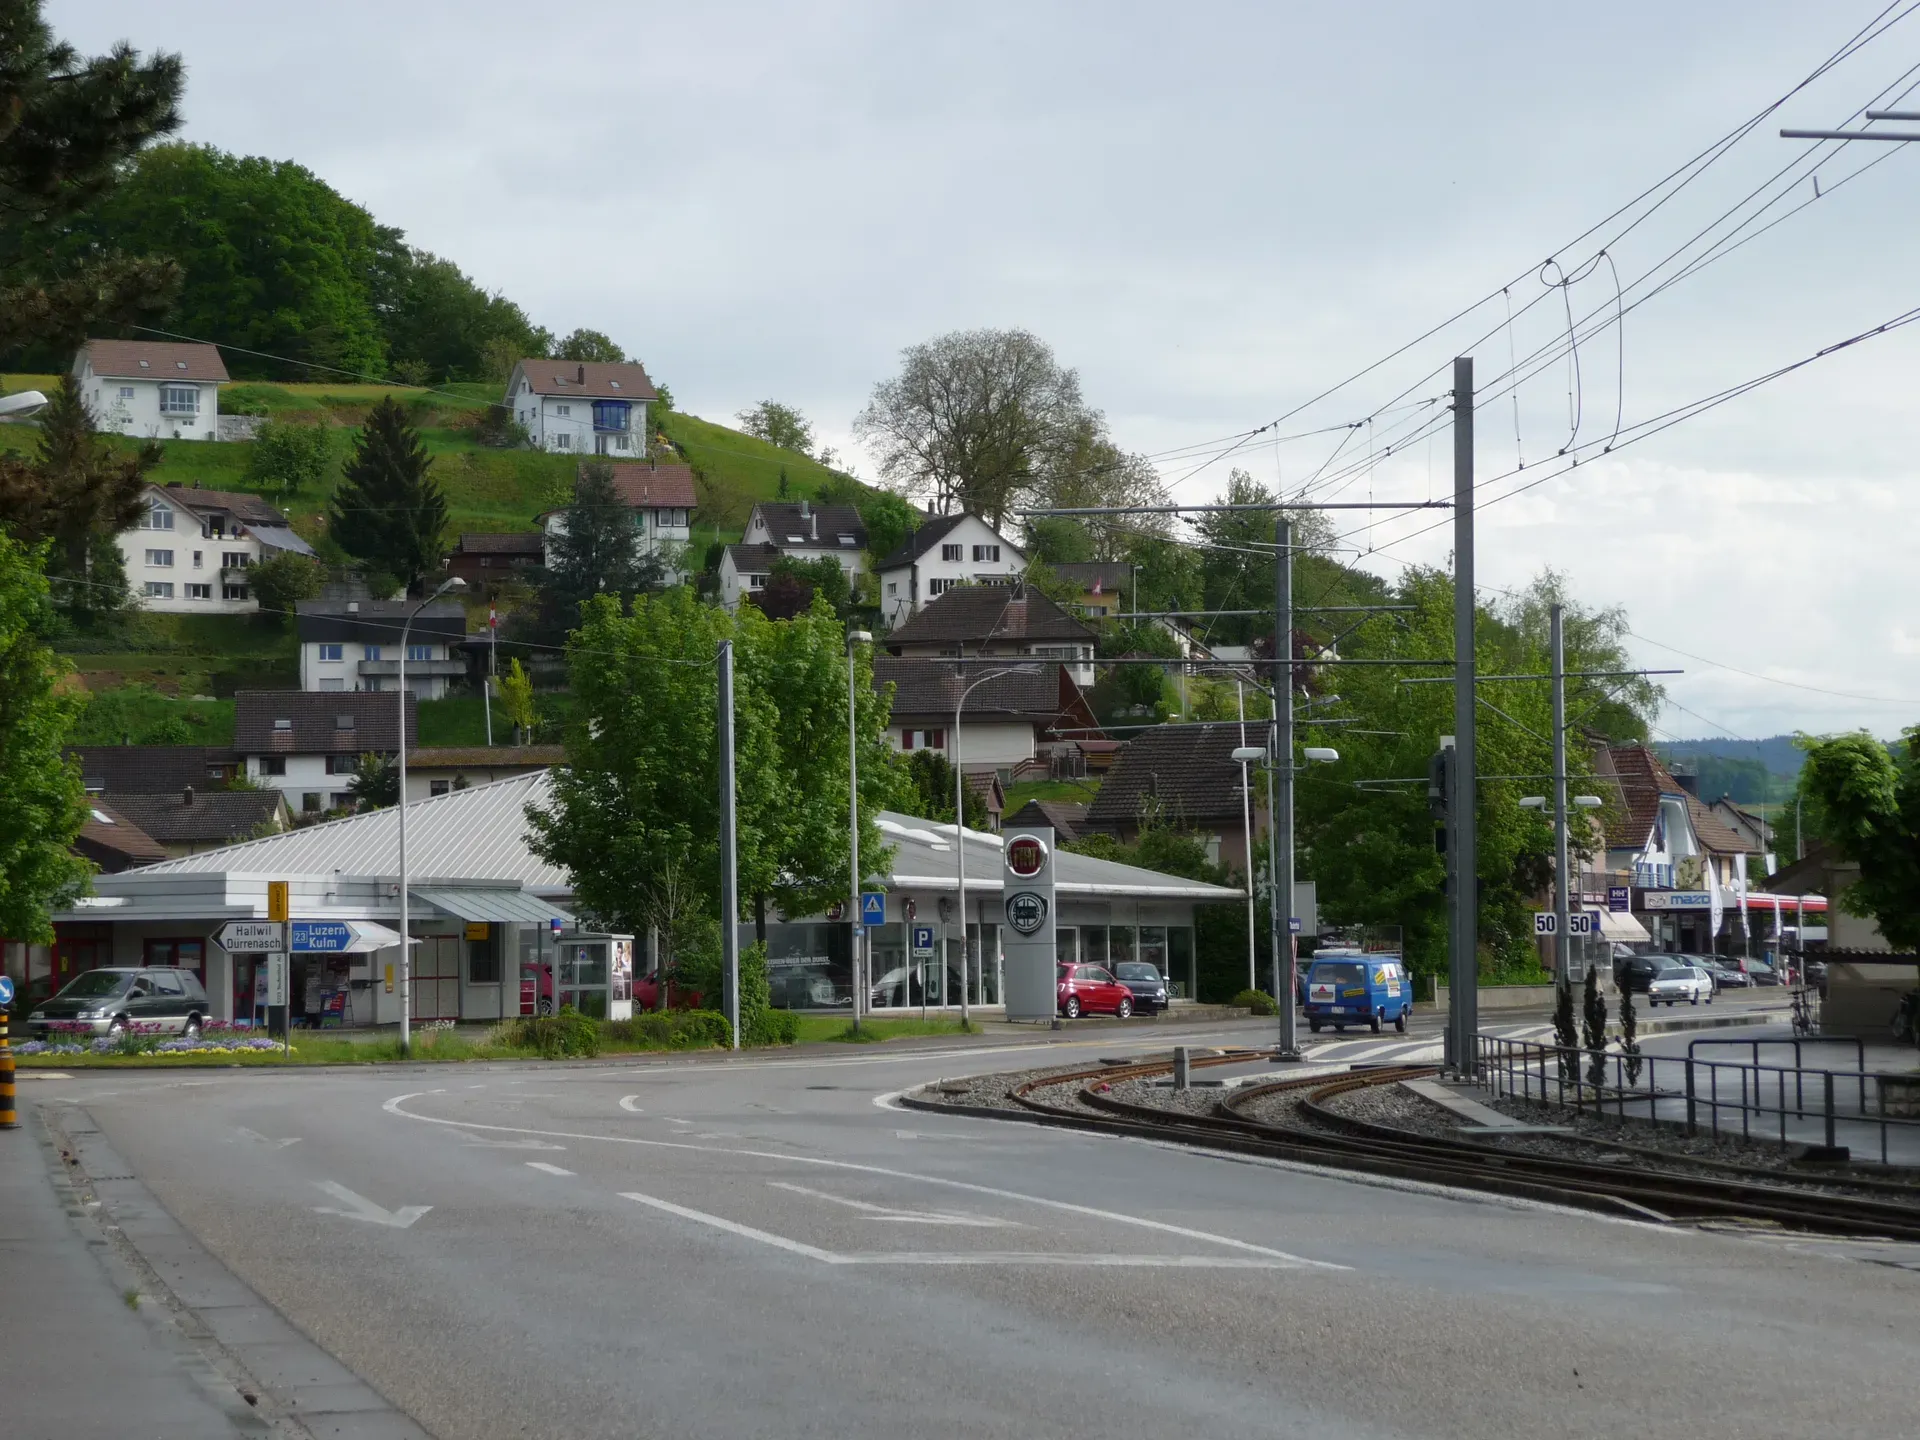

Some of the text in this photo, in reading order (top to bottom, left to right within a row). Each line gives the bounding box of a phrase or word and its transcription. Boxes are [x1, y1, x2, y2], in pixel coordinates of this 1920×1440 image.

[1014, 846, 1037, 867] FIAT
[1670, 895, 1712, 904] mazd
[1536, 915, 1555, 932] 50
[1570, 916, 1589, 933] 50
[236, 925, 272, 936] Hallwil
[309, 925, 346, 936] Luzern
[295, 932, 306, 942] 23
[309, 937, 337, 948] Kulm
[918, 930, 929, 947] P
[226, 938, 280, 949] Dürrenäsch
